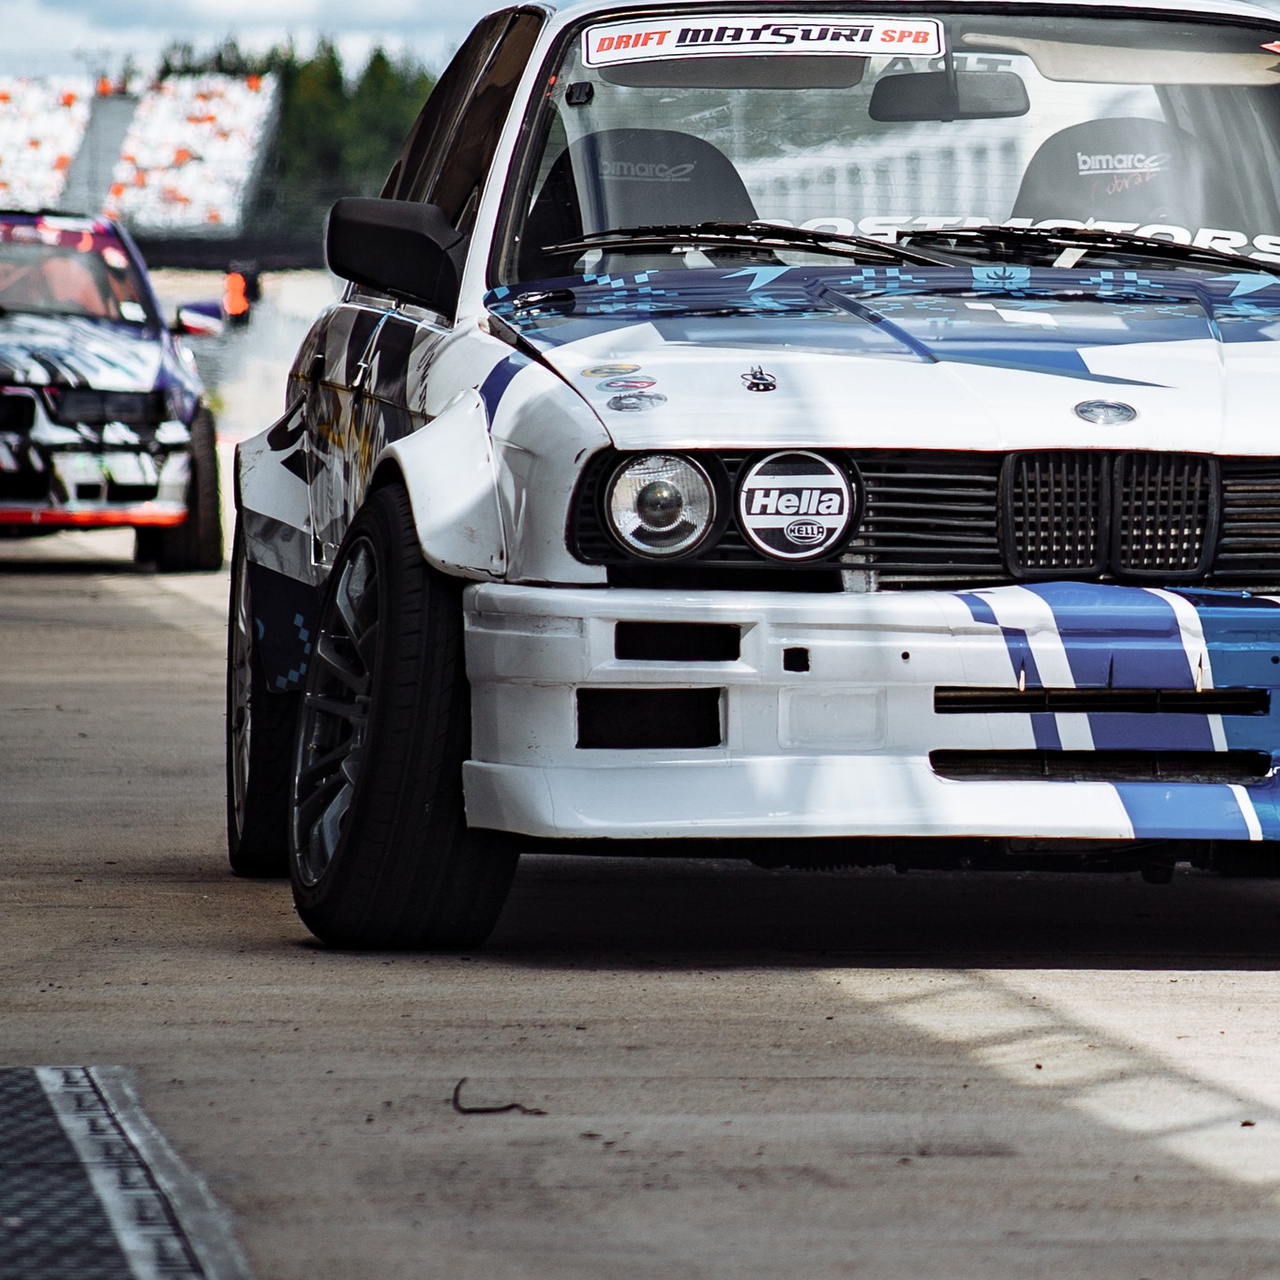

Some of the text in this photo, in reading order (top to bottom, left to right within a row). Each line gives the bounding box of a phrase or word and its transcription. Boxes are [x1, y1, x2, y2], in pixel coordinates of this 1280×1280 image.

[597, 25, 930, 52] DRIFT MATSURI SPB
[750, 489, 841, 515] Hella
[789, 525, 825, 537] HELLA
